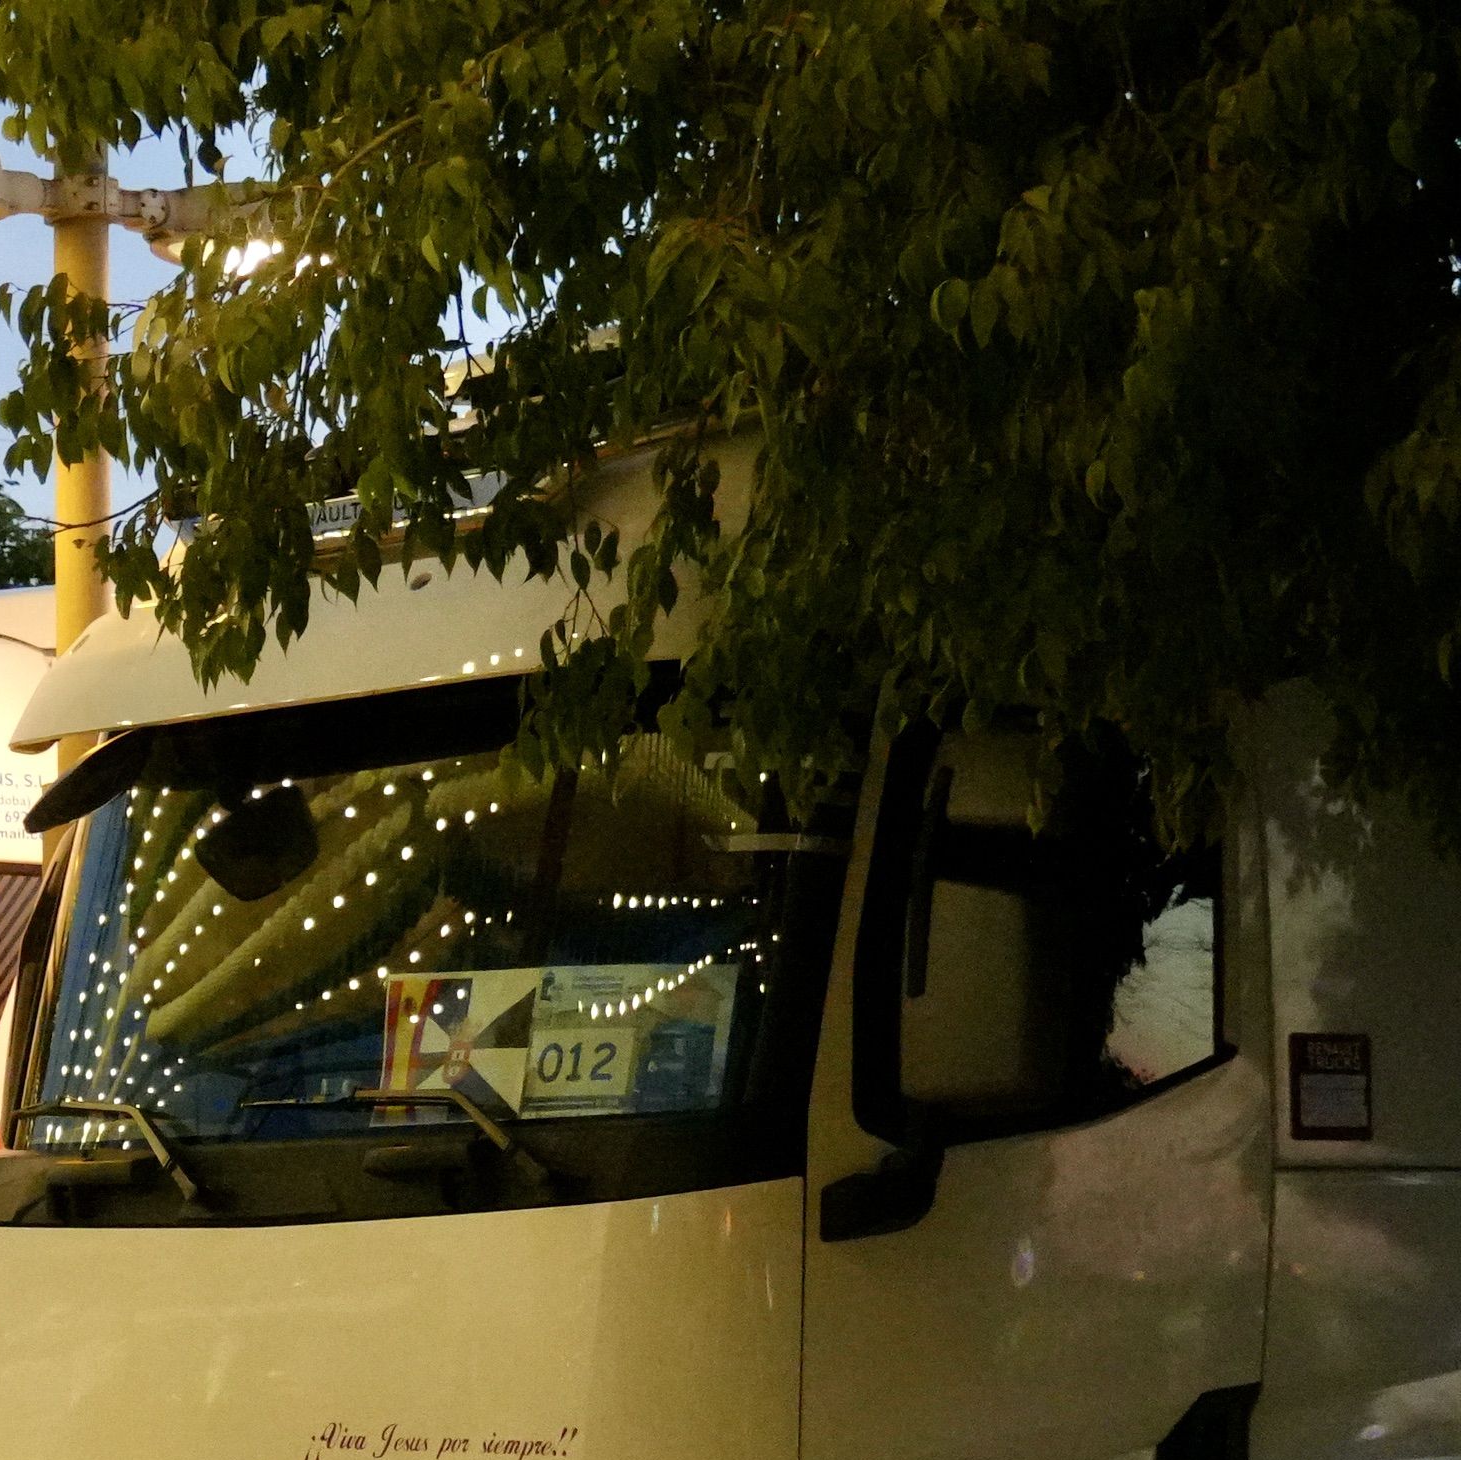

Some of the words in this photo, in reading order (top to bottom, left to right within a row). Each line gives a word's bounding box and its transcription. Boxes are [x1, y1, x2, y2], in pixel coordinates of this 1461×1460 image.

[310, 502, 361, 527] AULT
[537, 1042, 618, 1083] 012
[437, 1437, 469, 1460] por
